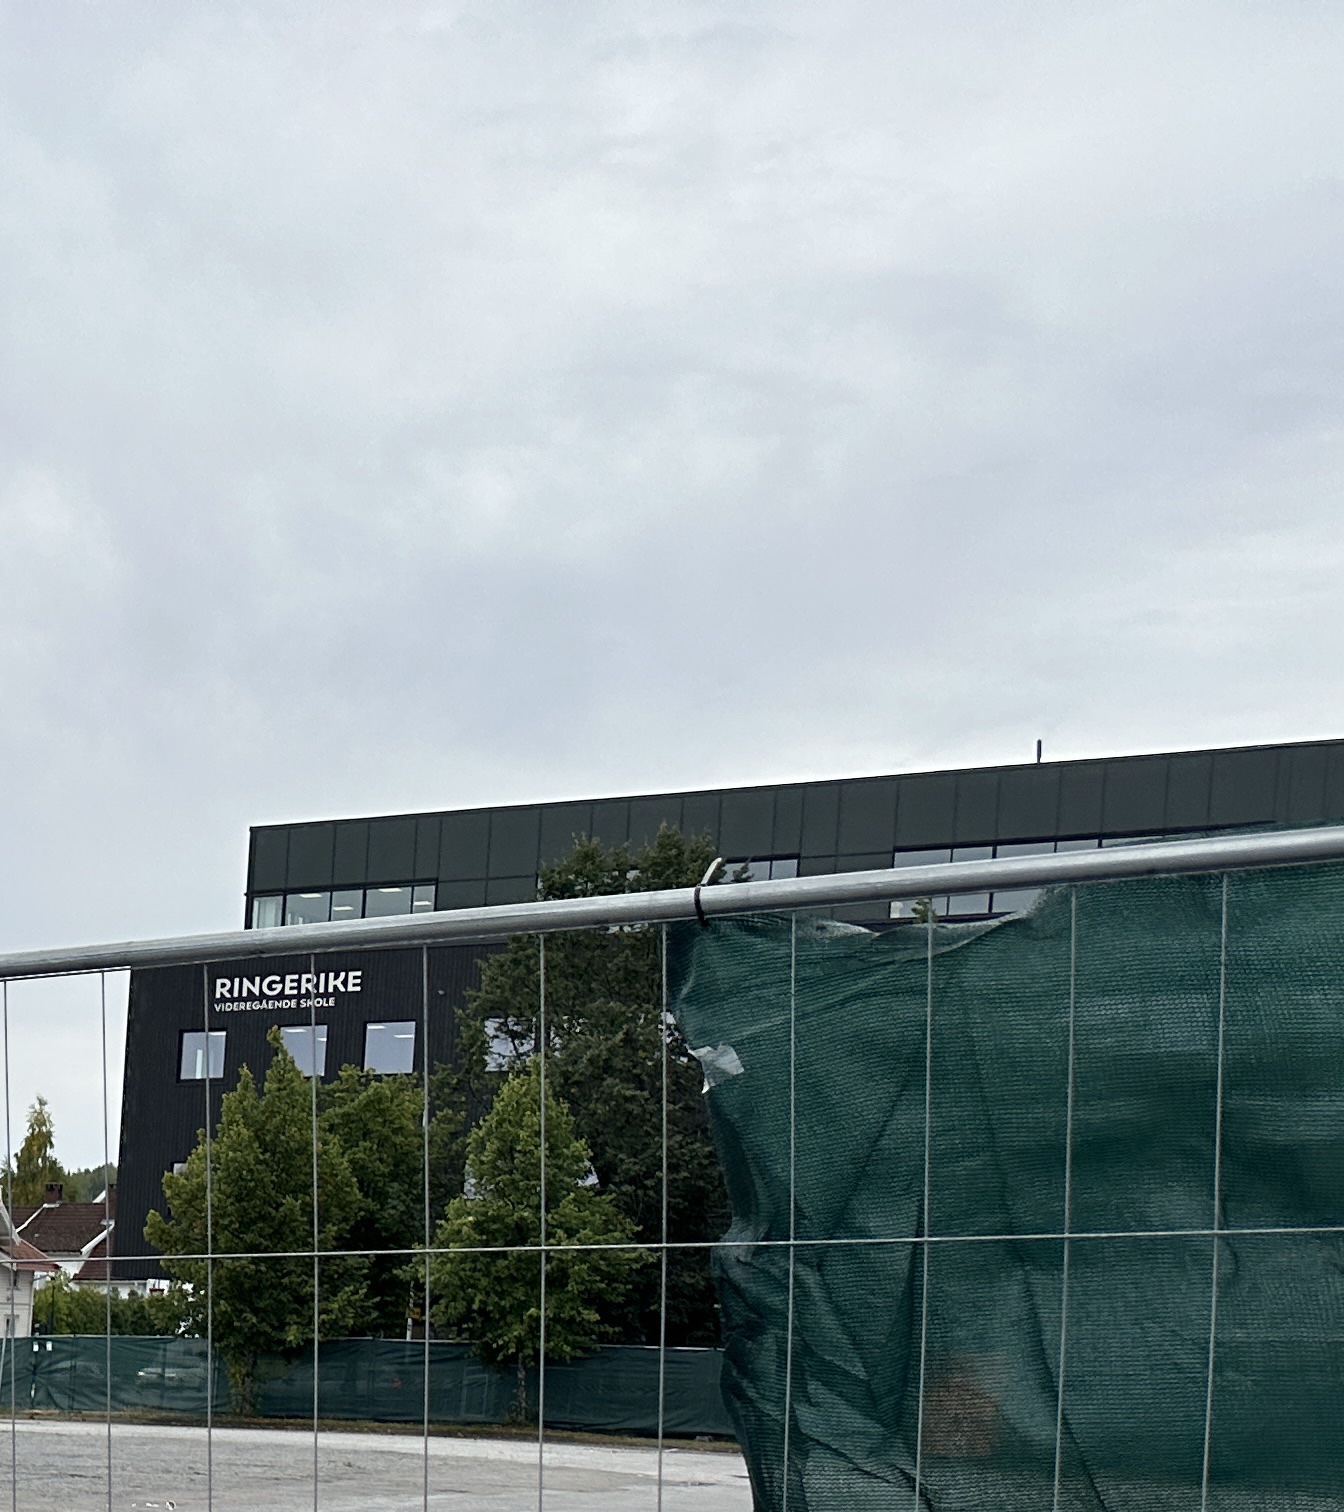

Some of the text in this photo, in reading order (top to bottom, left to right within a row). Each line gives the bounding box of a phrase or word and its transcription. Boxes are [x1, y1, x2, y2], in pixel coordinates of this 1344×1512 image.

[215, 970, 362, 999] RINGERIKE
[214, 997, 336, 1012] VIDEREGÅENDE SKOLE
